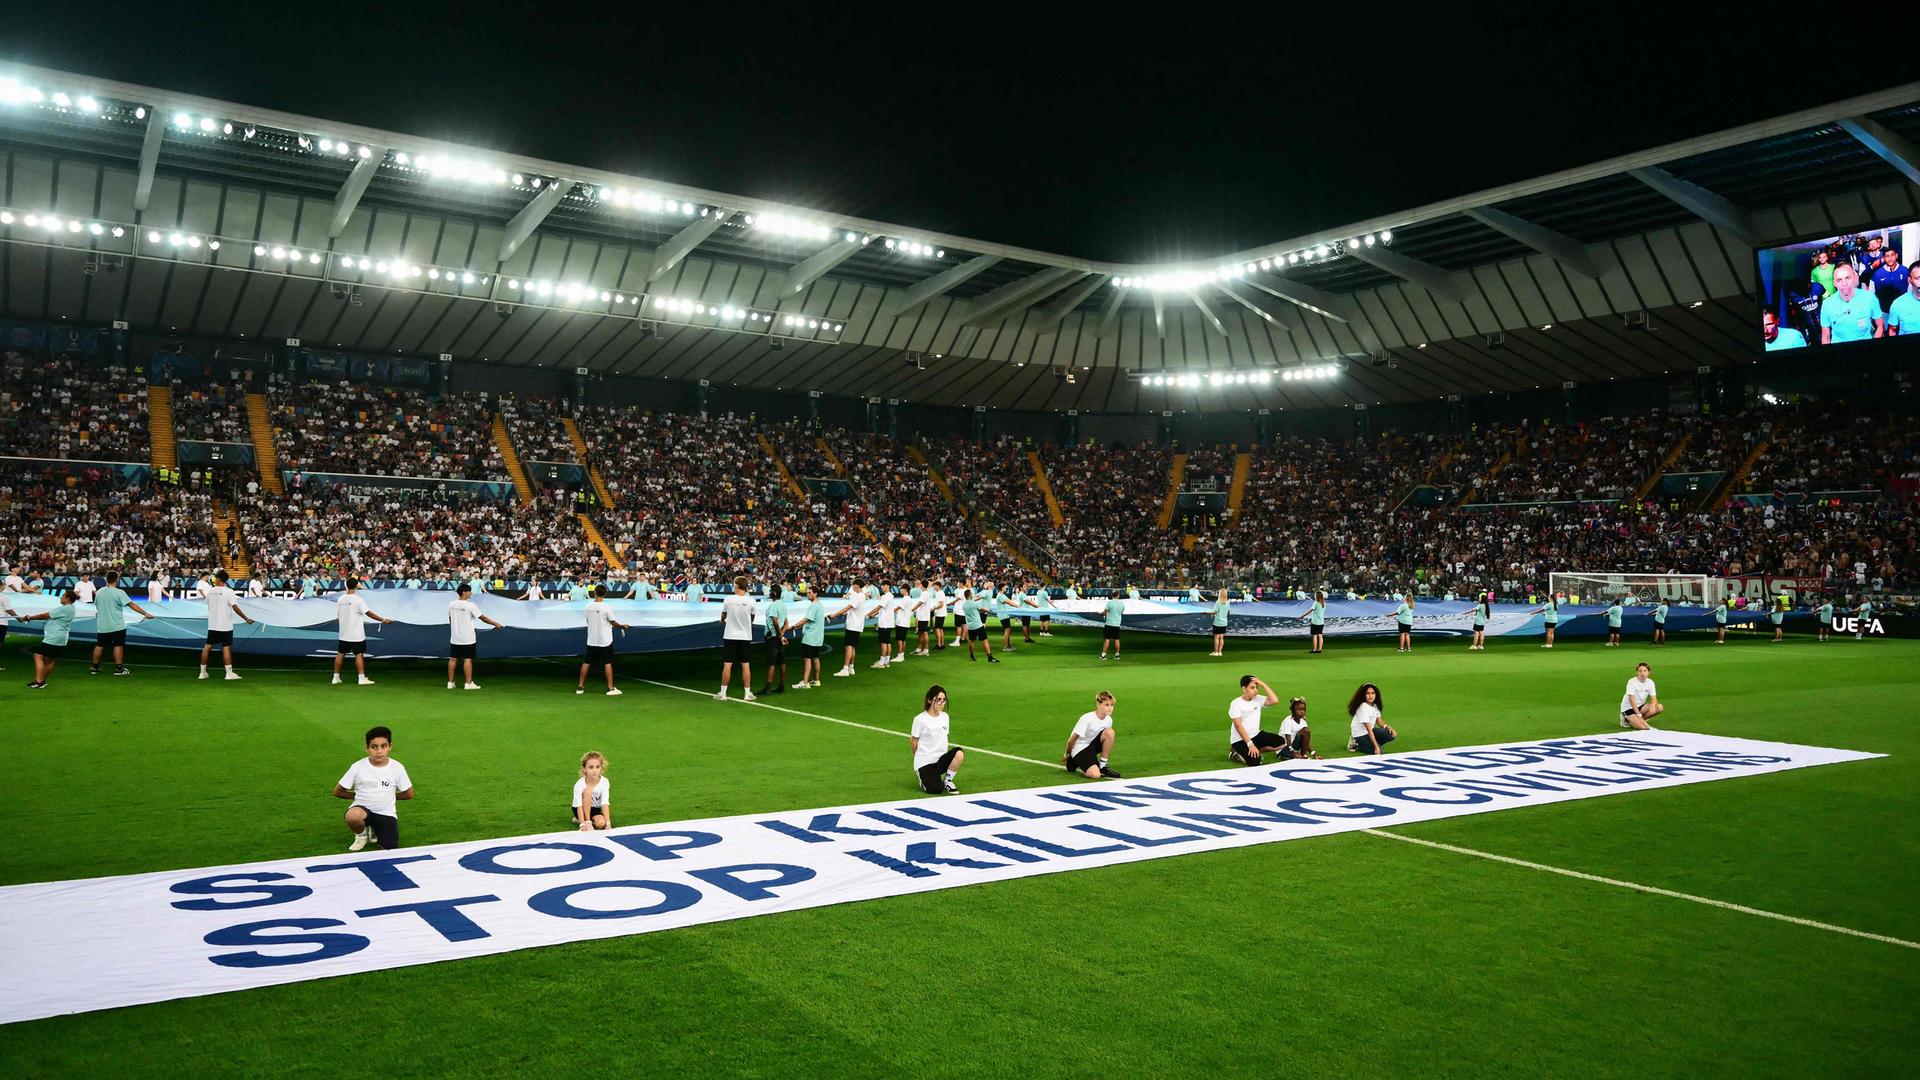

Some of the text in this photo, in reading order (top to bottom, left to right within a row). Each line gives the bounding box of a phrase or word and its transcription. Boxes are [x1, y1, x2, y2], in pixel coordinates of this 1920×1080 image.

[170, 737, 1683, 911] STOP KILLING CHILDREN
[203, 750, 1792, 968] STOP KILLING CIVILIANS
